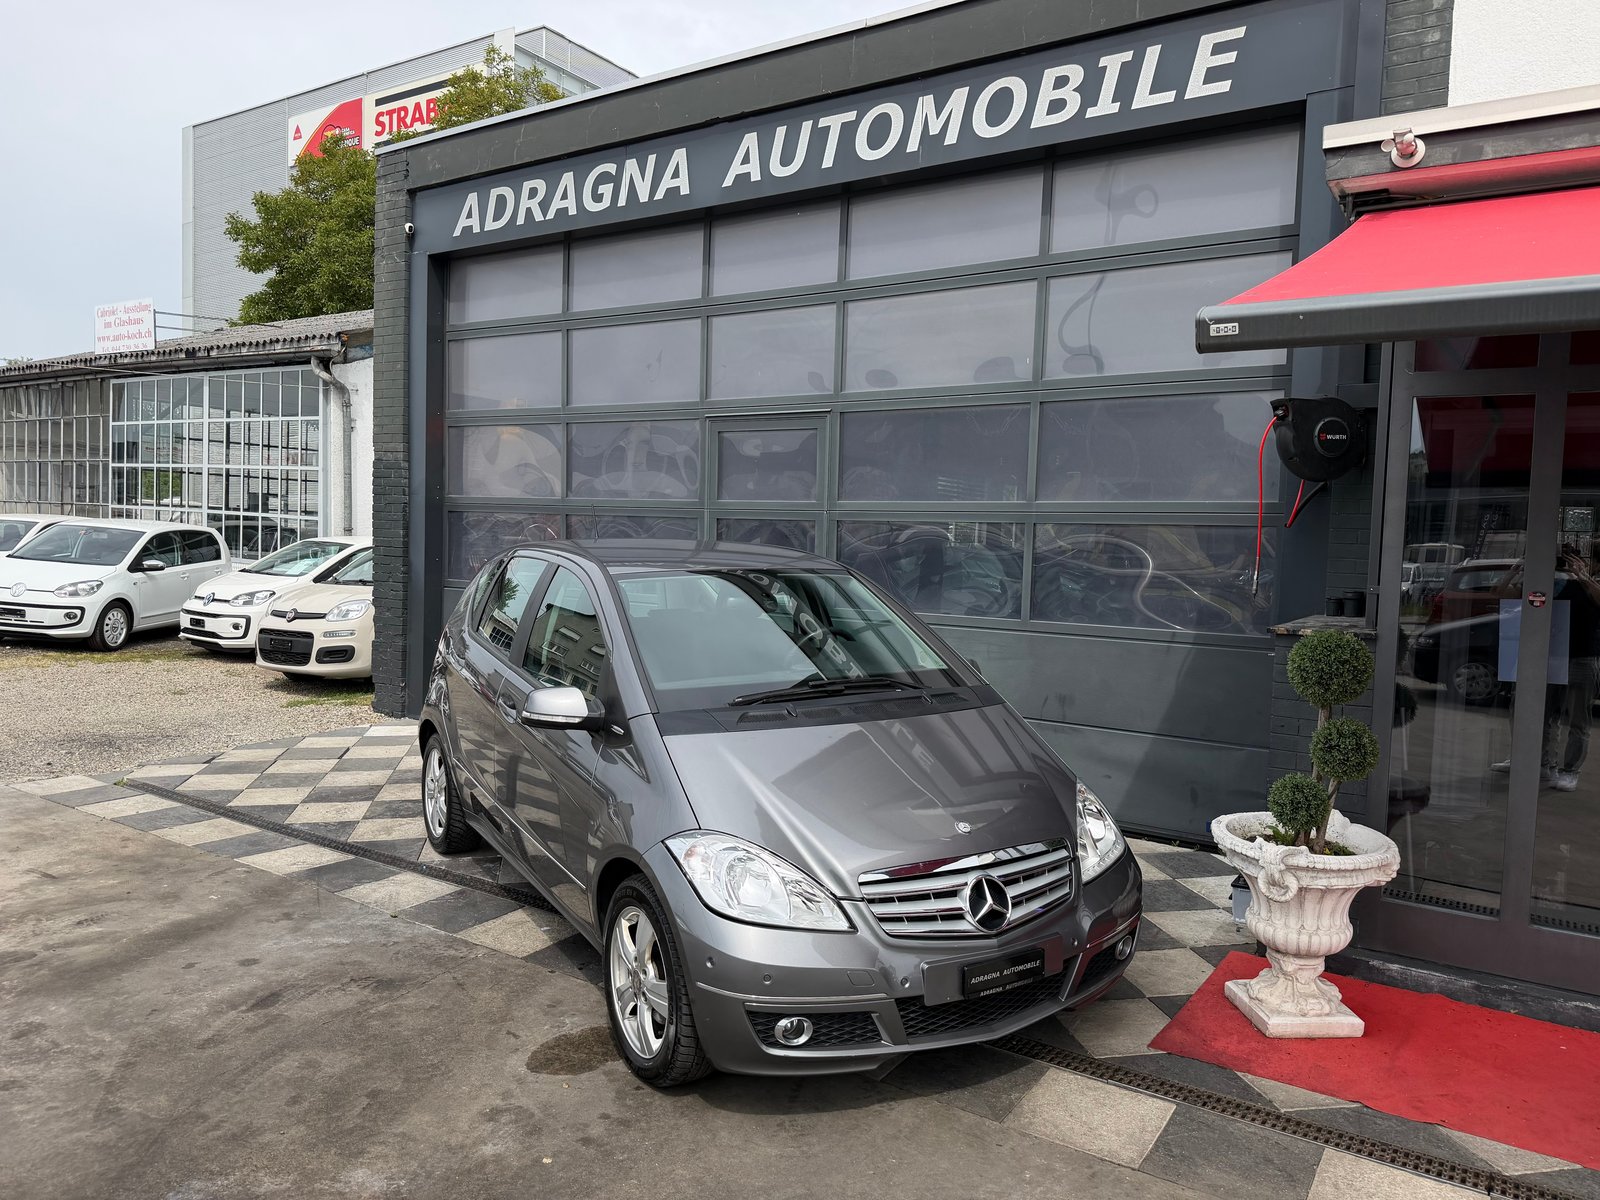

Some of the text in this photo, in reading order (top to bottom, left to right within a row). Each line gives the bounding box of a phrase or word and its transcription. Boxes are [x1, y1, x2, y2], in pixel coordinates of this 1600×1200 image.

[374, 97, 439, 137] STRAB
[453, 26, 1247, 236] ADRAGNA AUTOMOBILE
[123, 302, 151, 314] Ausstellung
[104, 316, 144, 329] im Glashaus
[97, 328, 152, 343] www.auto-koch.ch
[970, 960, 1040, 984] ADRAGNA AUTOMOBILE
